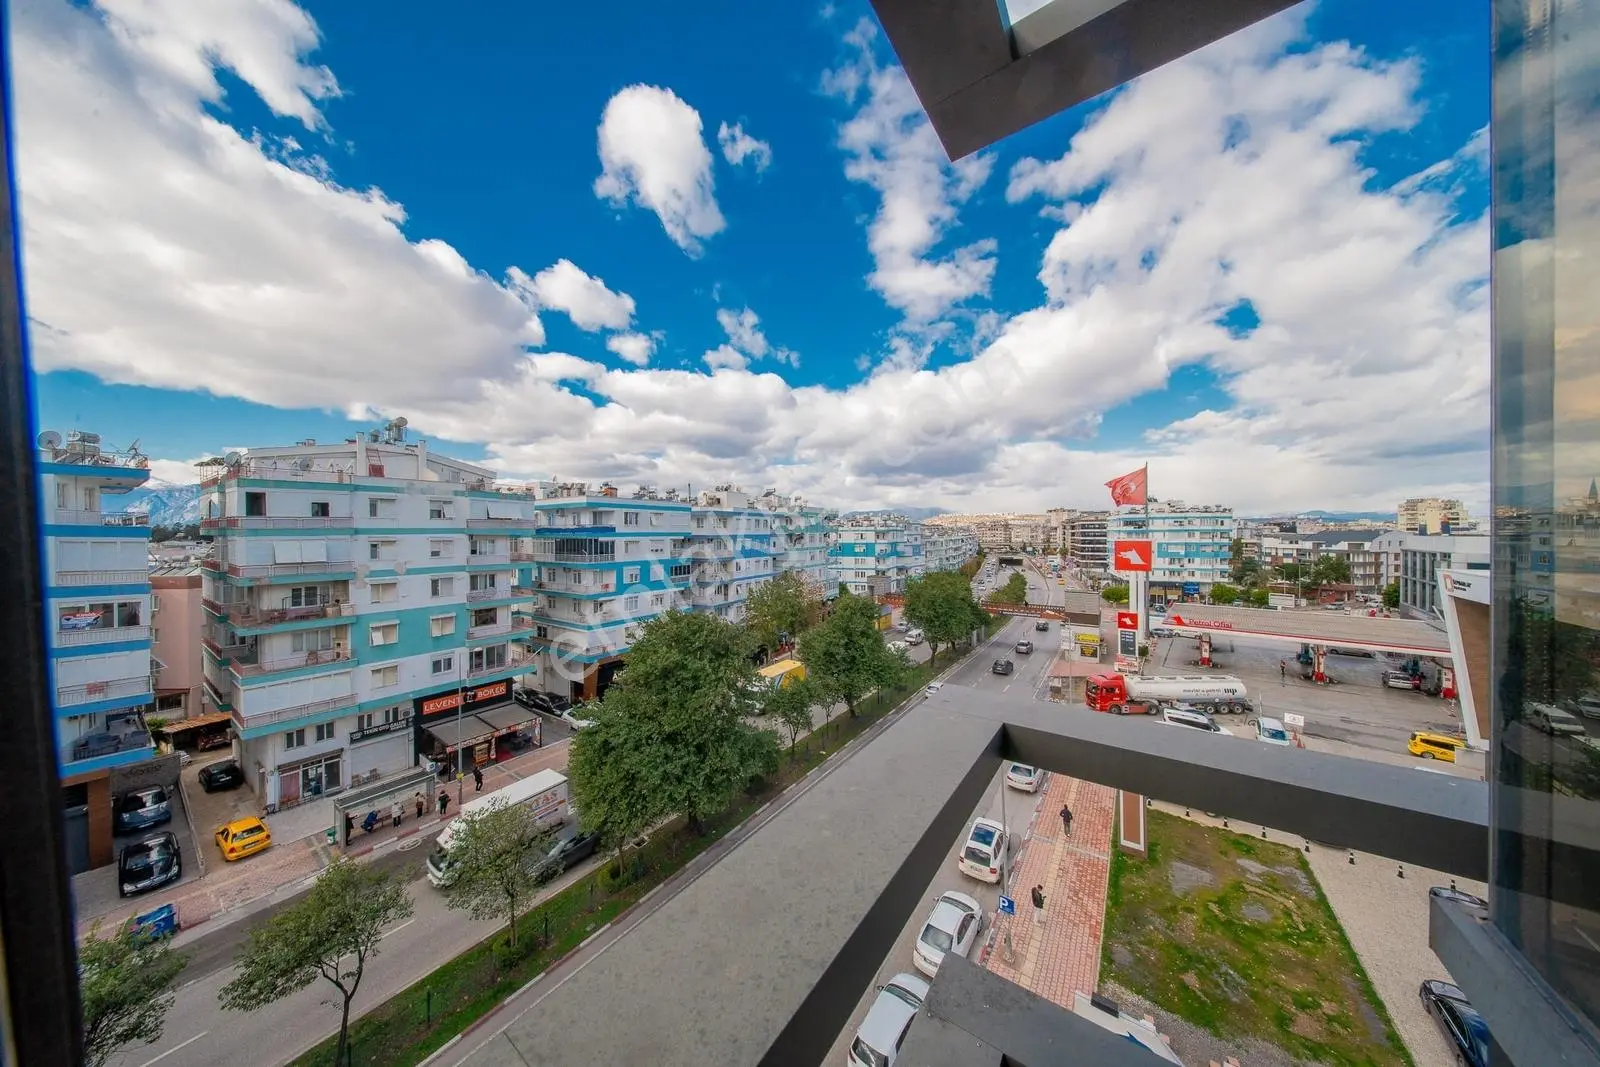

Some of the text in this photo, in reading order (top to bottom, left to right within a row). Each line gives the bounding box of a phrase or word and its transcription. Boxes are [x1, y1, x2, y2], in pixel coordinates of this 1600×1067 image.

[1188, 618, 1212, 627] Petrol
[424, 696, 462, 711] LEVENT
[1000, 897, 1008, 909] P
